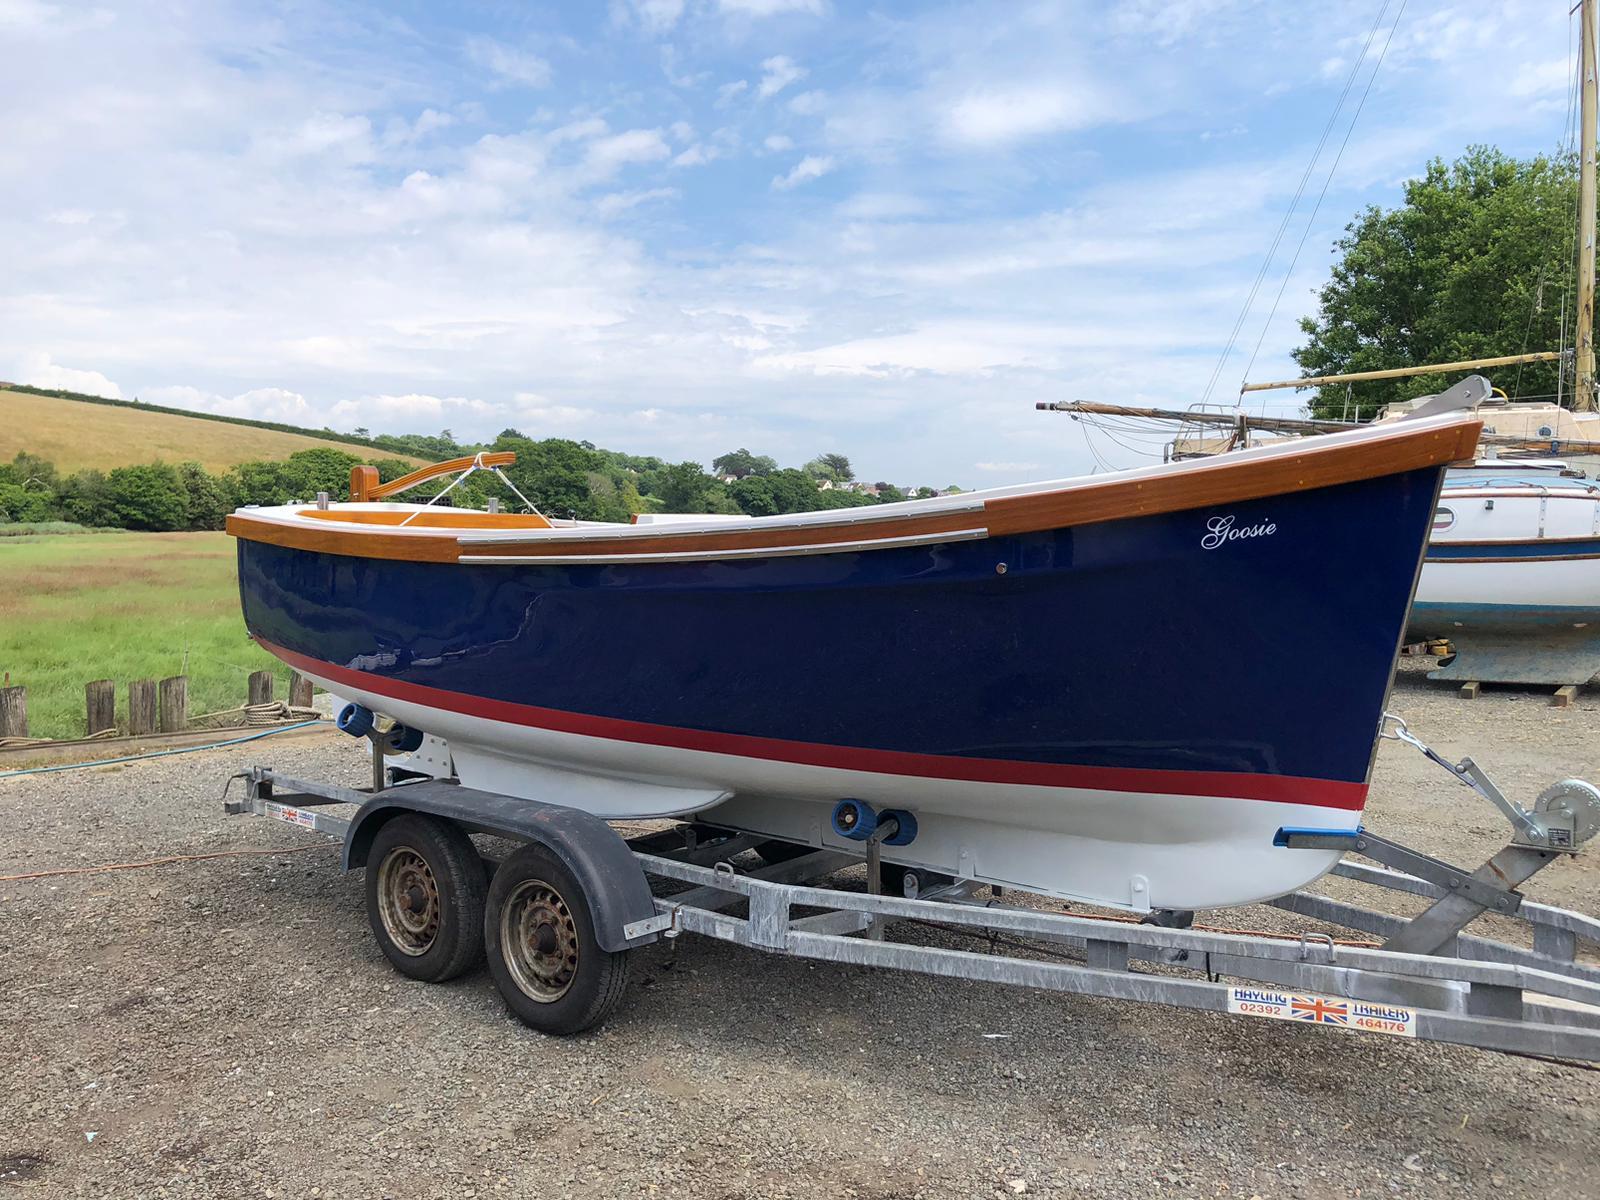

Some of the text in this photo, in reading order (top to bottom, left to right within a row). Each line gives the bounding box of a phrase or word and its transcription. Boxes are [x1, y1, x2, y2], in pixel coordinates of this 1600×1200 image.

[1201, 515, 1277, 549] Goosie
[1235, 989, 1286, 1003] HAYLING
[1240, 1003, 1406, 1032] 02392 464176
